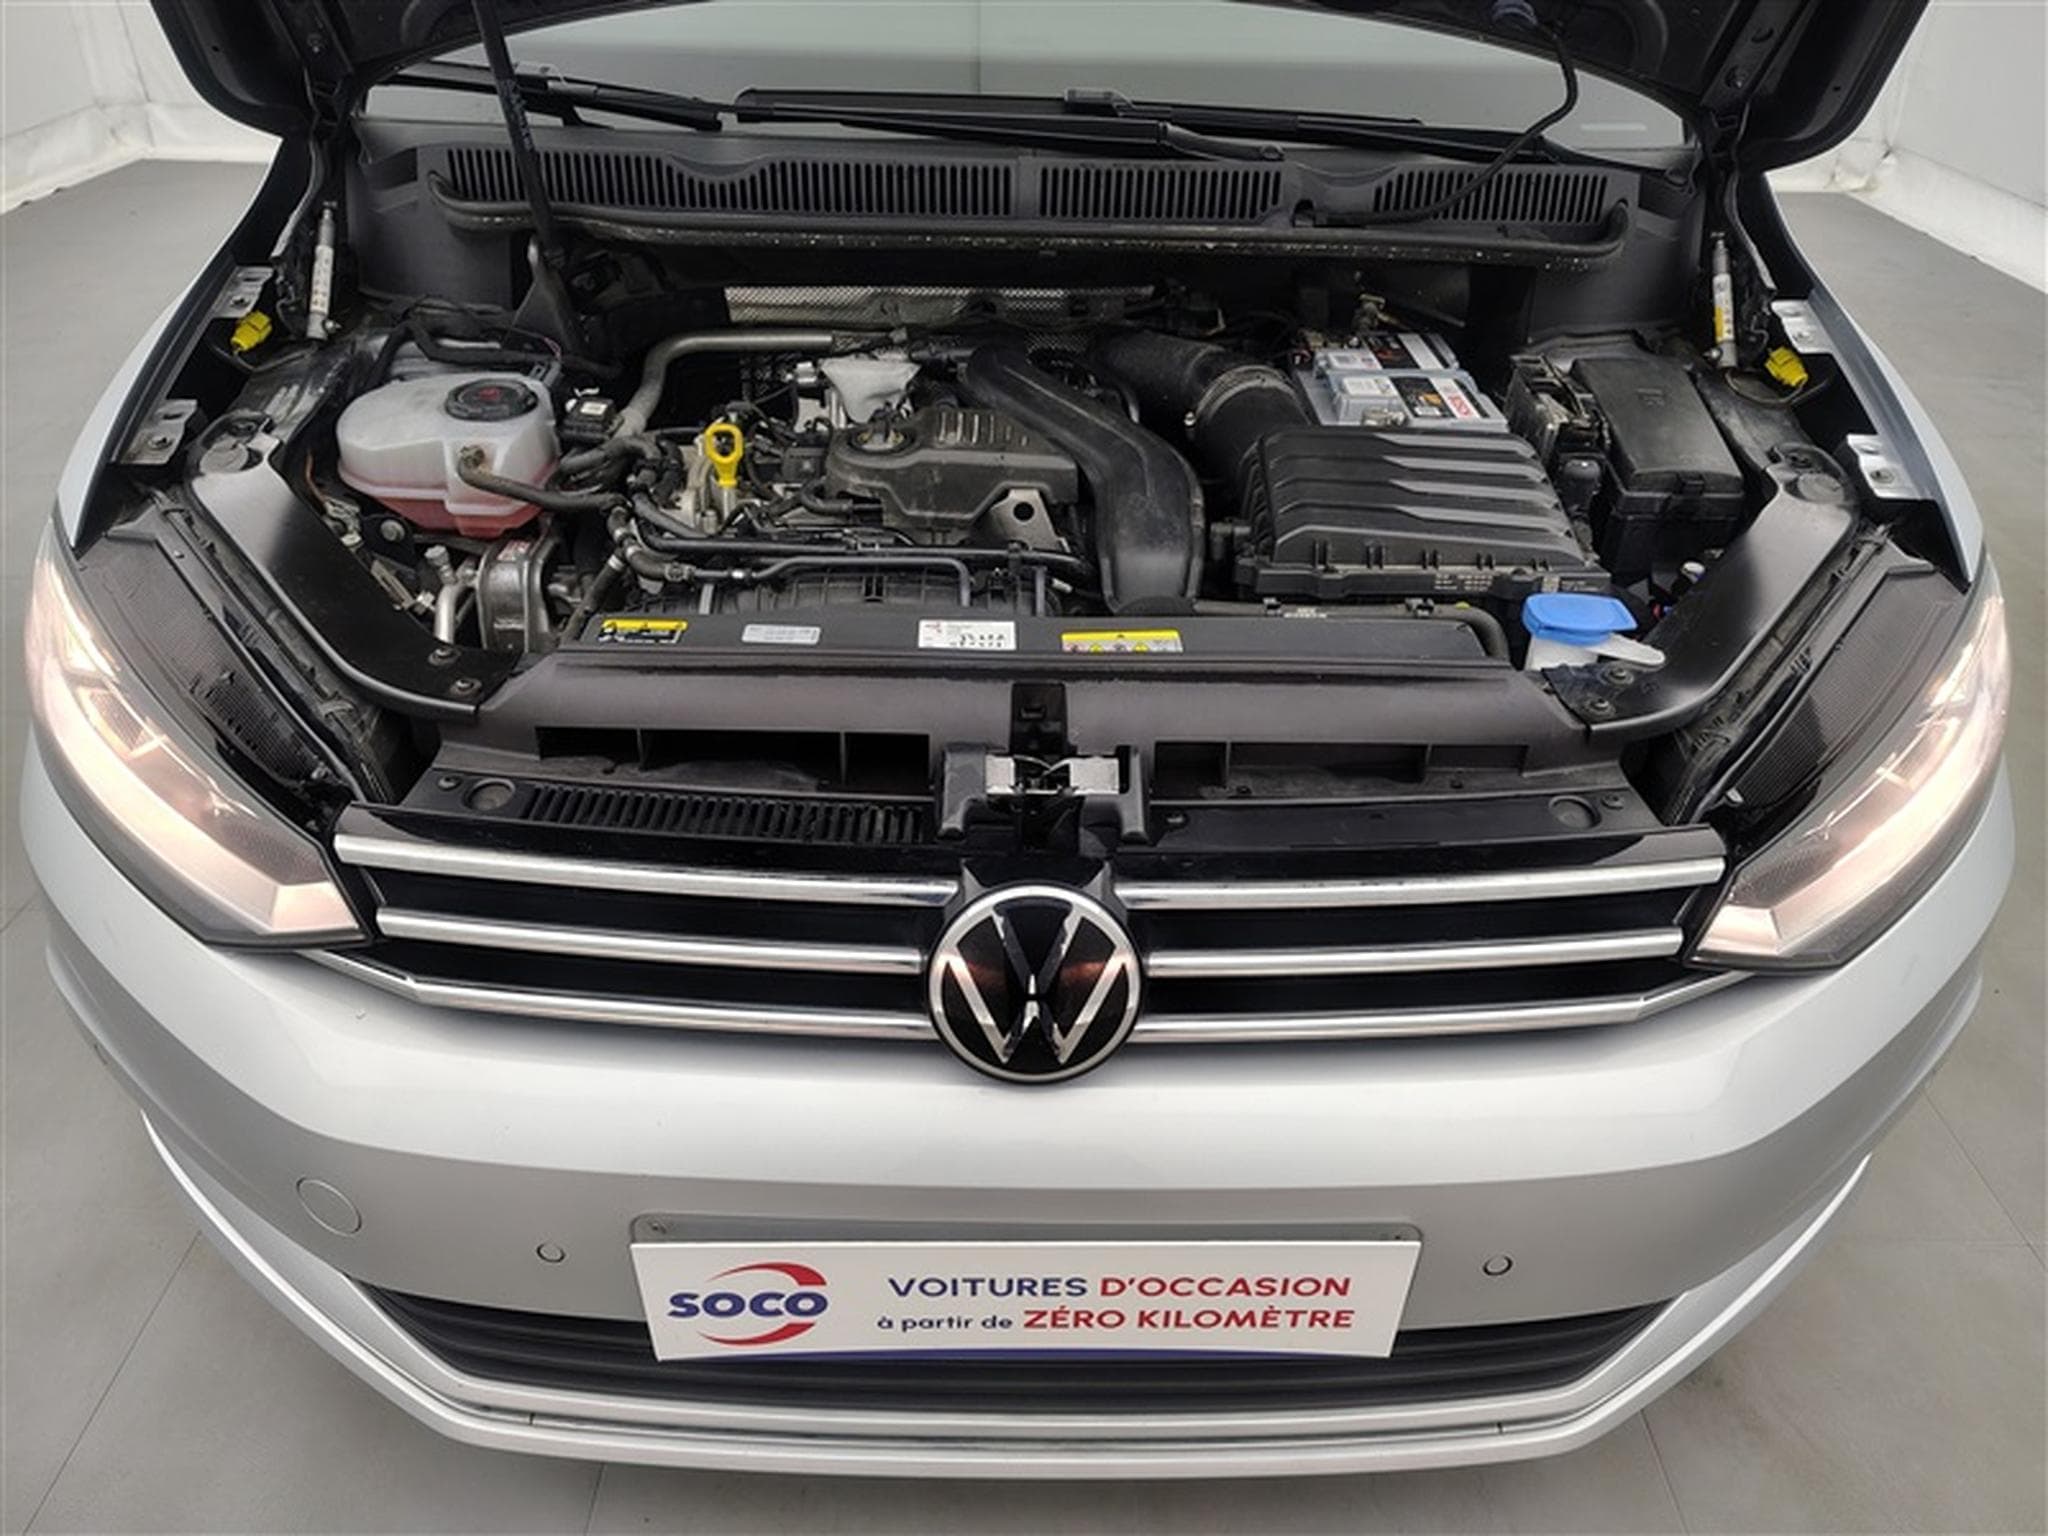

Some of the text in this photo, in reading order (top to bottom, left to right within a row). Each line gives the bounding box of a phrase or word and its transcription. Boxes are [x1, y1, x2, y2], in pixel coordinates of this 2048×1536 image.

[887, 1276, 1352, 1298] VOITURES D'OCCASION
[667, 1291, 829, 1319] SOCO
[877, 1306, 1356, 1333] à partir de ZÉRO KILOMÈTRE
